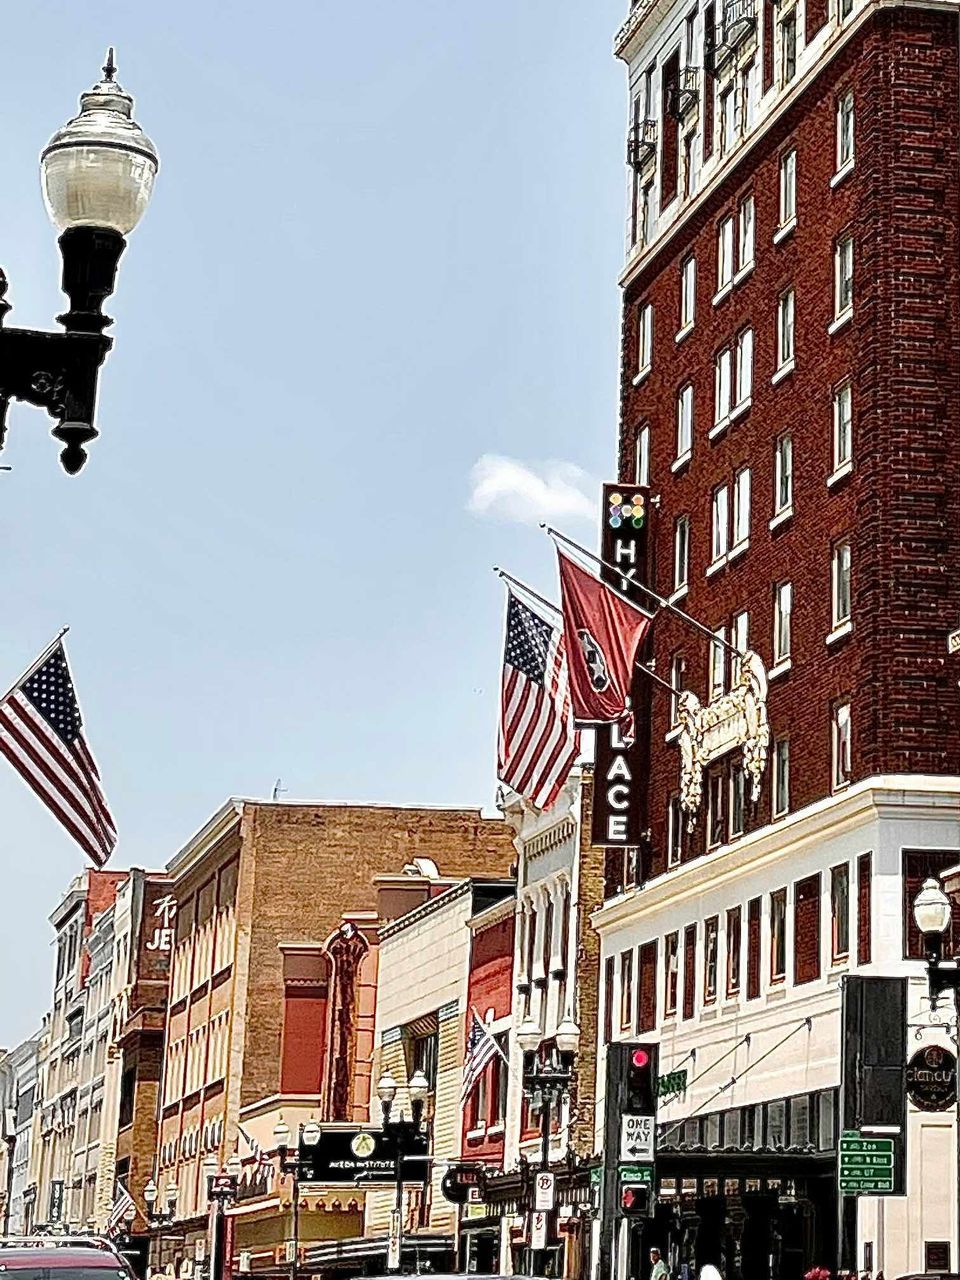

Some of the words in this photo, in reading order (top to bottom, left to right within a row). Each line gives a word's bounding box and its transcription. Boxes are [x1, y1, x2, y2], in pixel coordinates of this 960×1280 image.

[606, 718, 632, 841] LACE
[627, 1118, 650, 1131] ONE
[626, 1130, 651, 1143] WAY
[356, 1160, 395, 1169] INSTITUTE
